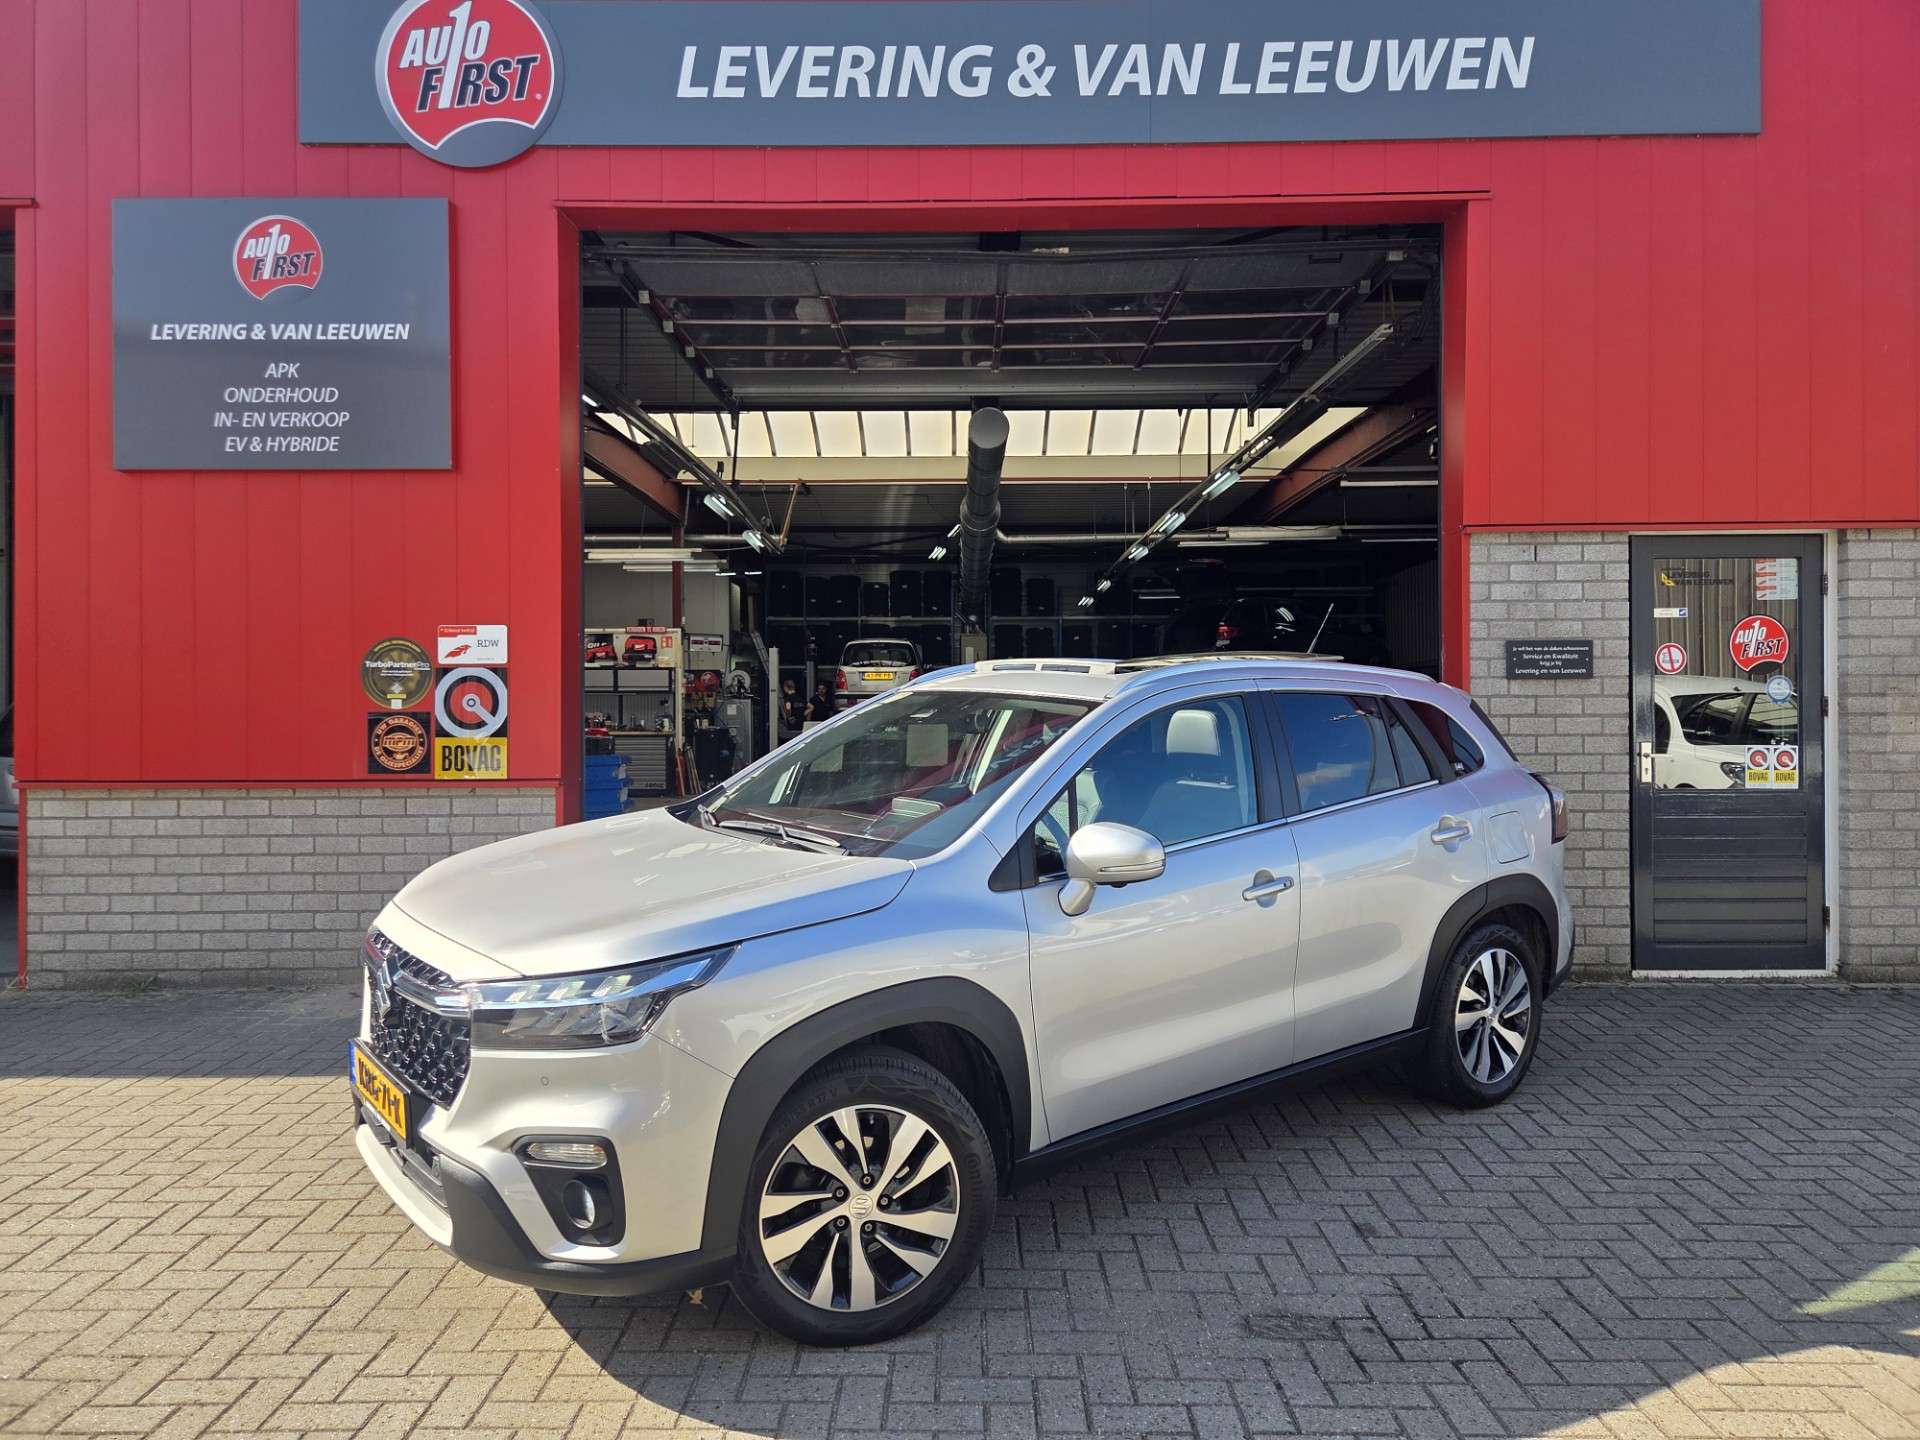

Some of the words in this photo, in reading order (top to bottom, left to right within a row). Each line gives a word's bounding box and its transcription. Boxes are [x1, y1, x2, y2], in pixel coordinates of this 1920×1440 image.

[676, 44, 993, 98] LEVERING
[1007, 43, 1057, 97] &
[1074, 43, 1206, 97] VAN
[1219, 36, 1536, 95] LEEUWEN
[416, 54, 541, 113] FIRST
[251, 251, 317, 281] FIRST
[151, 323, 248, 341] LEVERING
[250, 323, 267, 341] &
[271, 323, 313, 341] VAN
[316, 323, 410, 341] LEEUWEN
[264, 362, 301, 379] APK
[224, 387, 340, 403] ONDERHOUD
[213, 411, 240, 428] IN-
[242, 411, 266, 428] EN
[269, 411, 351, 428] VERKOOP
[224, 436, 248, 452] EV
[250, 436, 263, 452] &
[266, 436, 341, 452] HYBRIDE
[477, 639, 499, 648] RDW
[1740, 637, 1784, 660] FIRST
[441, 745, 501, 772] BOVAG
[1748, 772, 1769, 782] BOVAG
[1775, 772, 1795, 782] BOVAG
